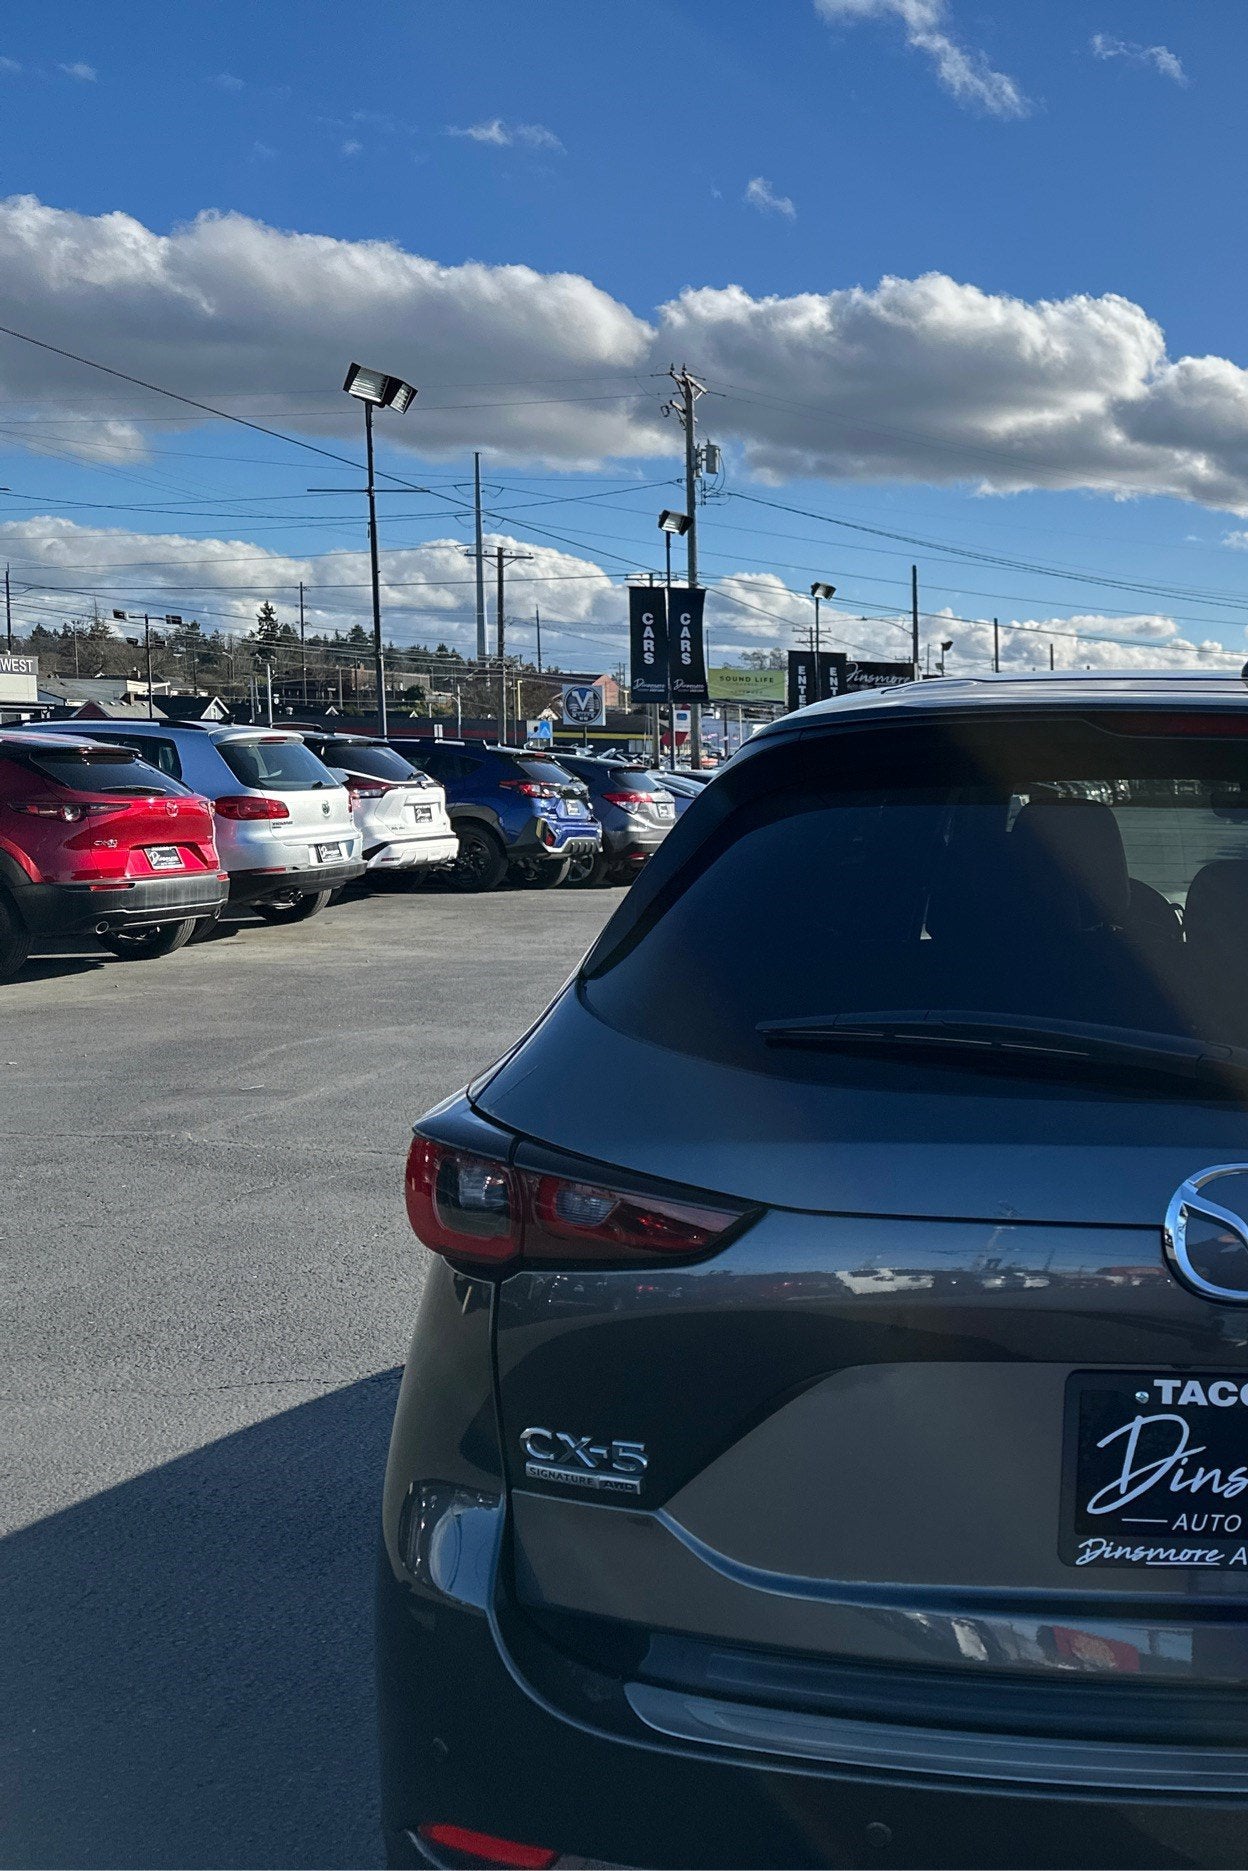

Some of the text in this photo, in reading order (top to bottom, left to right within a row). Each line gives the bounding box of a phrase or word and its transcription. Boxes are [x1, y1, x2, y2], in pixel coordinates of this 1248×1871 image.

[642, 612, 655, 665] CARS
[680, 612, 691, 665] CARS
[0, 658, 33, 672] WEST
[719, 675, 775, 684] SOUND LIFE
[520, 1426, 648, 1474] CX-5
[529, 1467, 594, 1486] SIGNATURE
[1172, 1513, 1242, 1533] AUTO
[1075, 1537, 1224, 1566] Dinsmore
